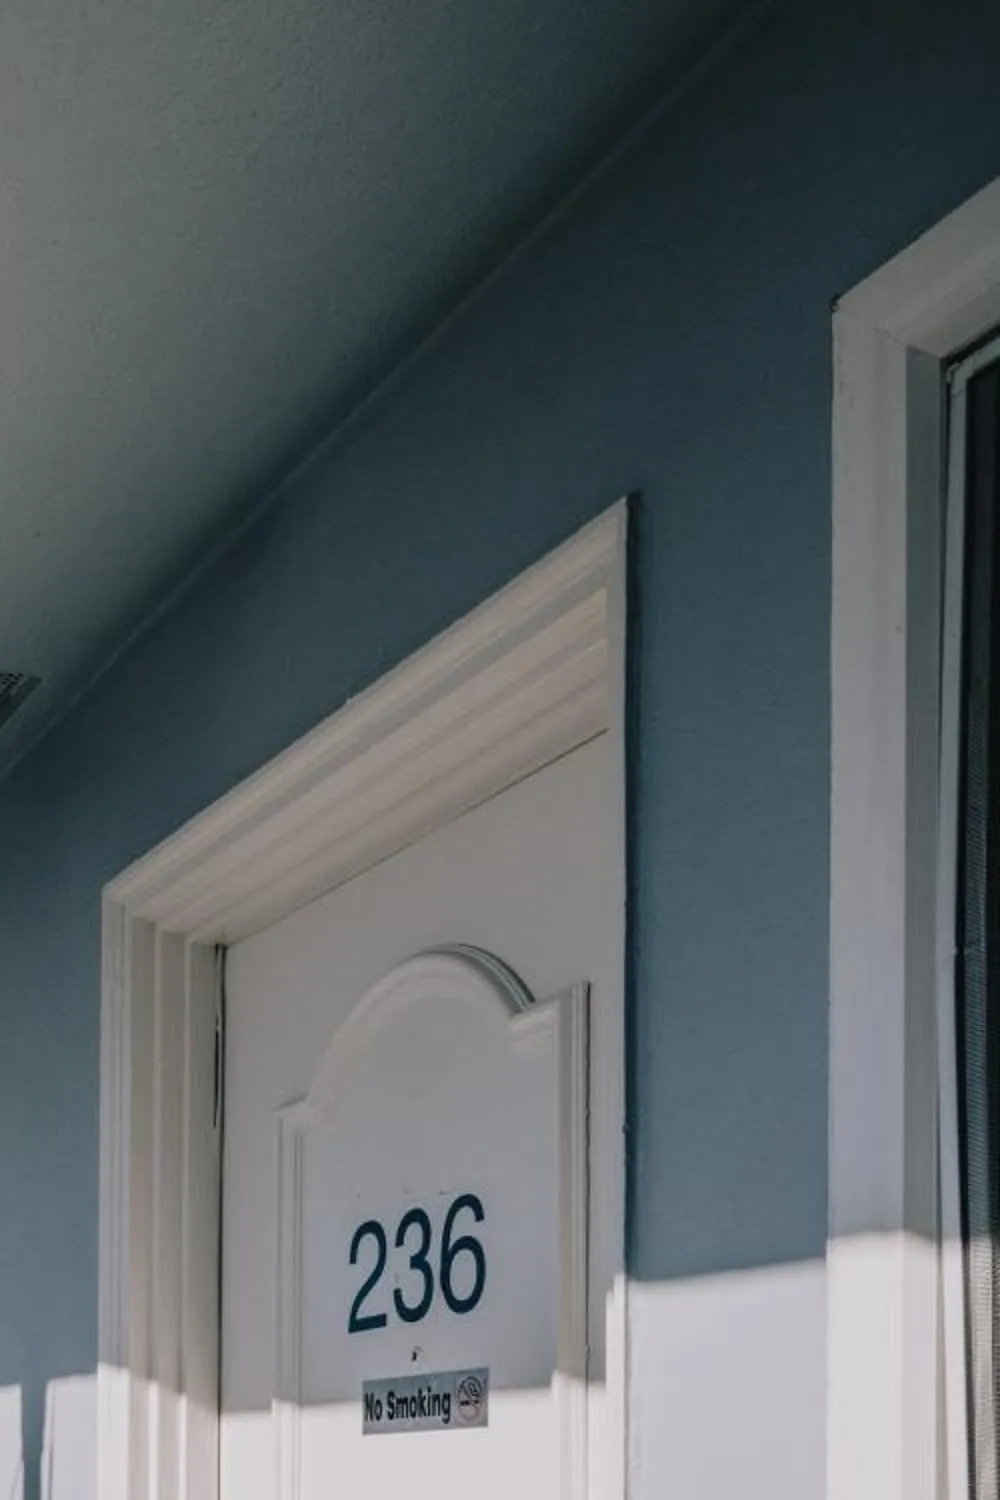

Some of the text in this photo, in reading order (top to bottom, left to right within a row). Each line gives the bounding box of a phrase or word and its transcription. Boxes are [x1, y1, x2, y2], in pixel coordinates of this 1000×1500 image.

[348, 1193, 486, 1333] 236
[364, 1386, 451, 1424] No Smoking
